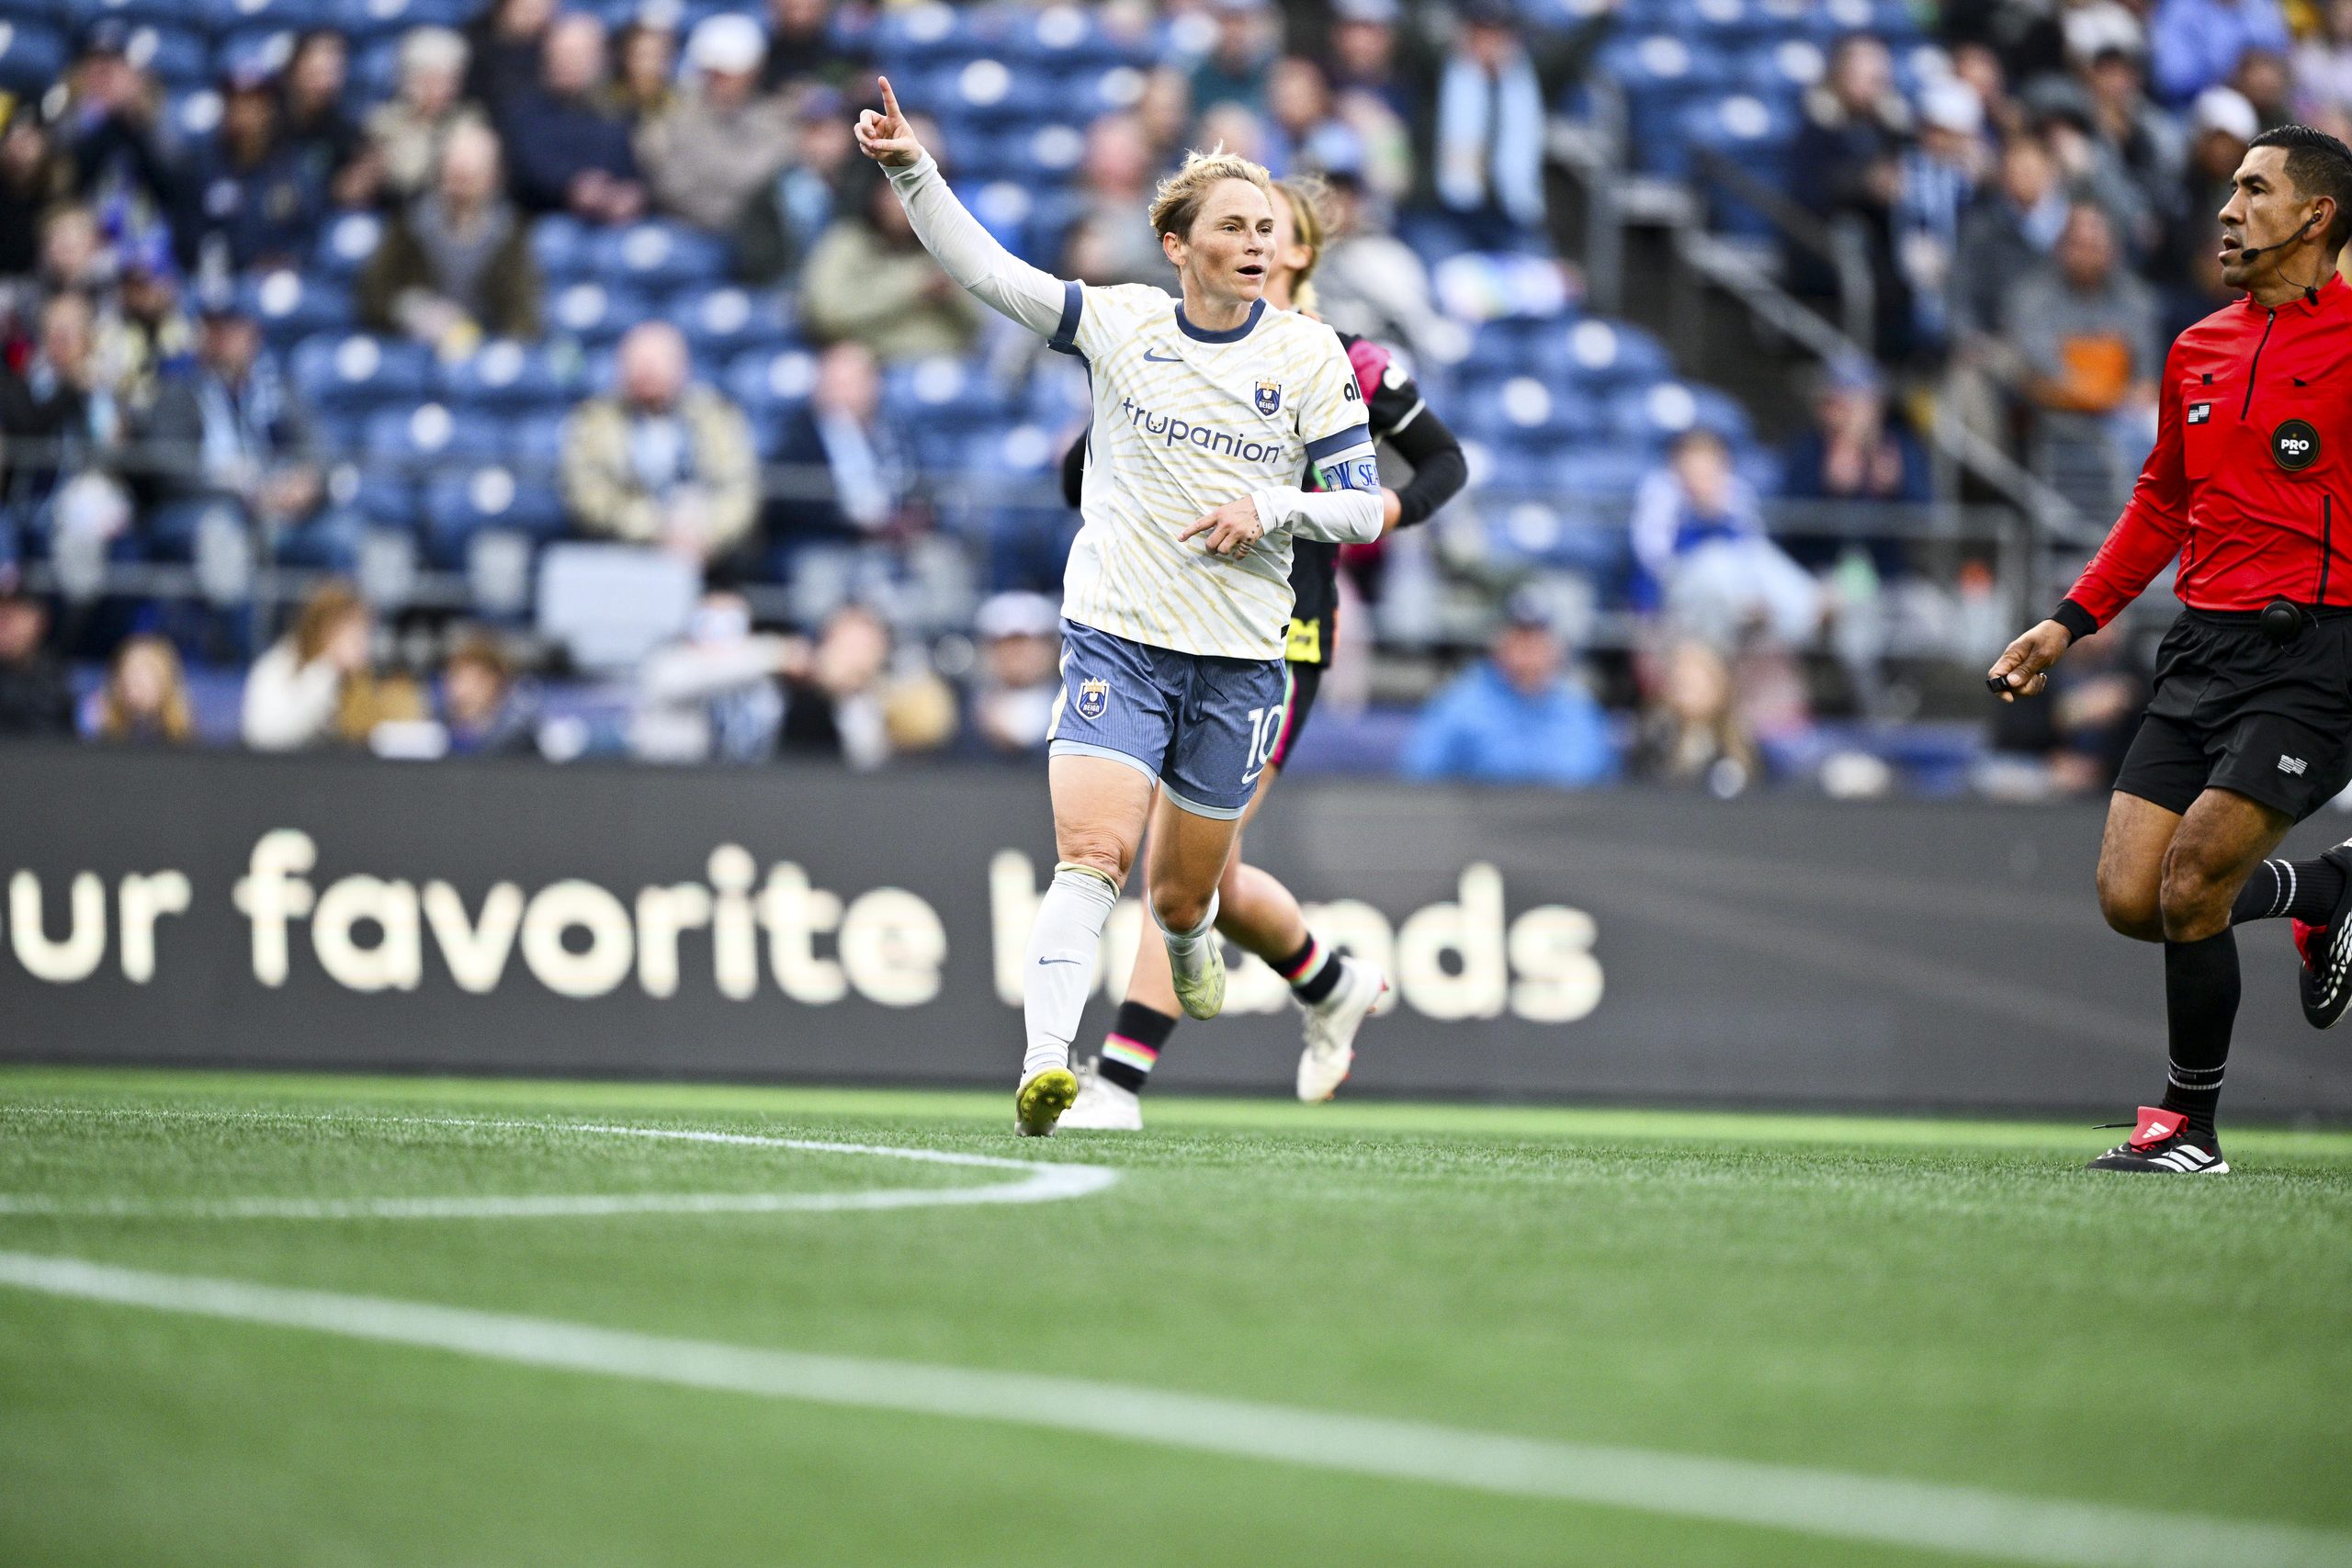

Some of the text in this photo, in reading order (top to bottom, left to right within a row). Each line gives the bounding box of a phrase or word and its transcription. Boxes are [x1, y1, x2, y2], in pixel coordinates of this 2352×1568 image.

[1123, 397, 1280, 463] trupanion
[2280, 438, 2310, 450] PRO
[1246, 705, 1283, 768] 10
[0, 870, 191, 983] ur
[232, 829, 947, 1007] favorite
